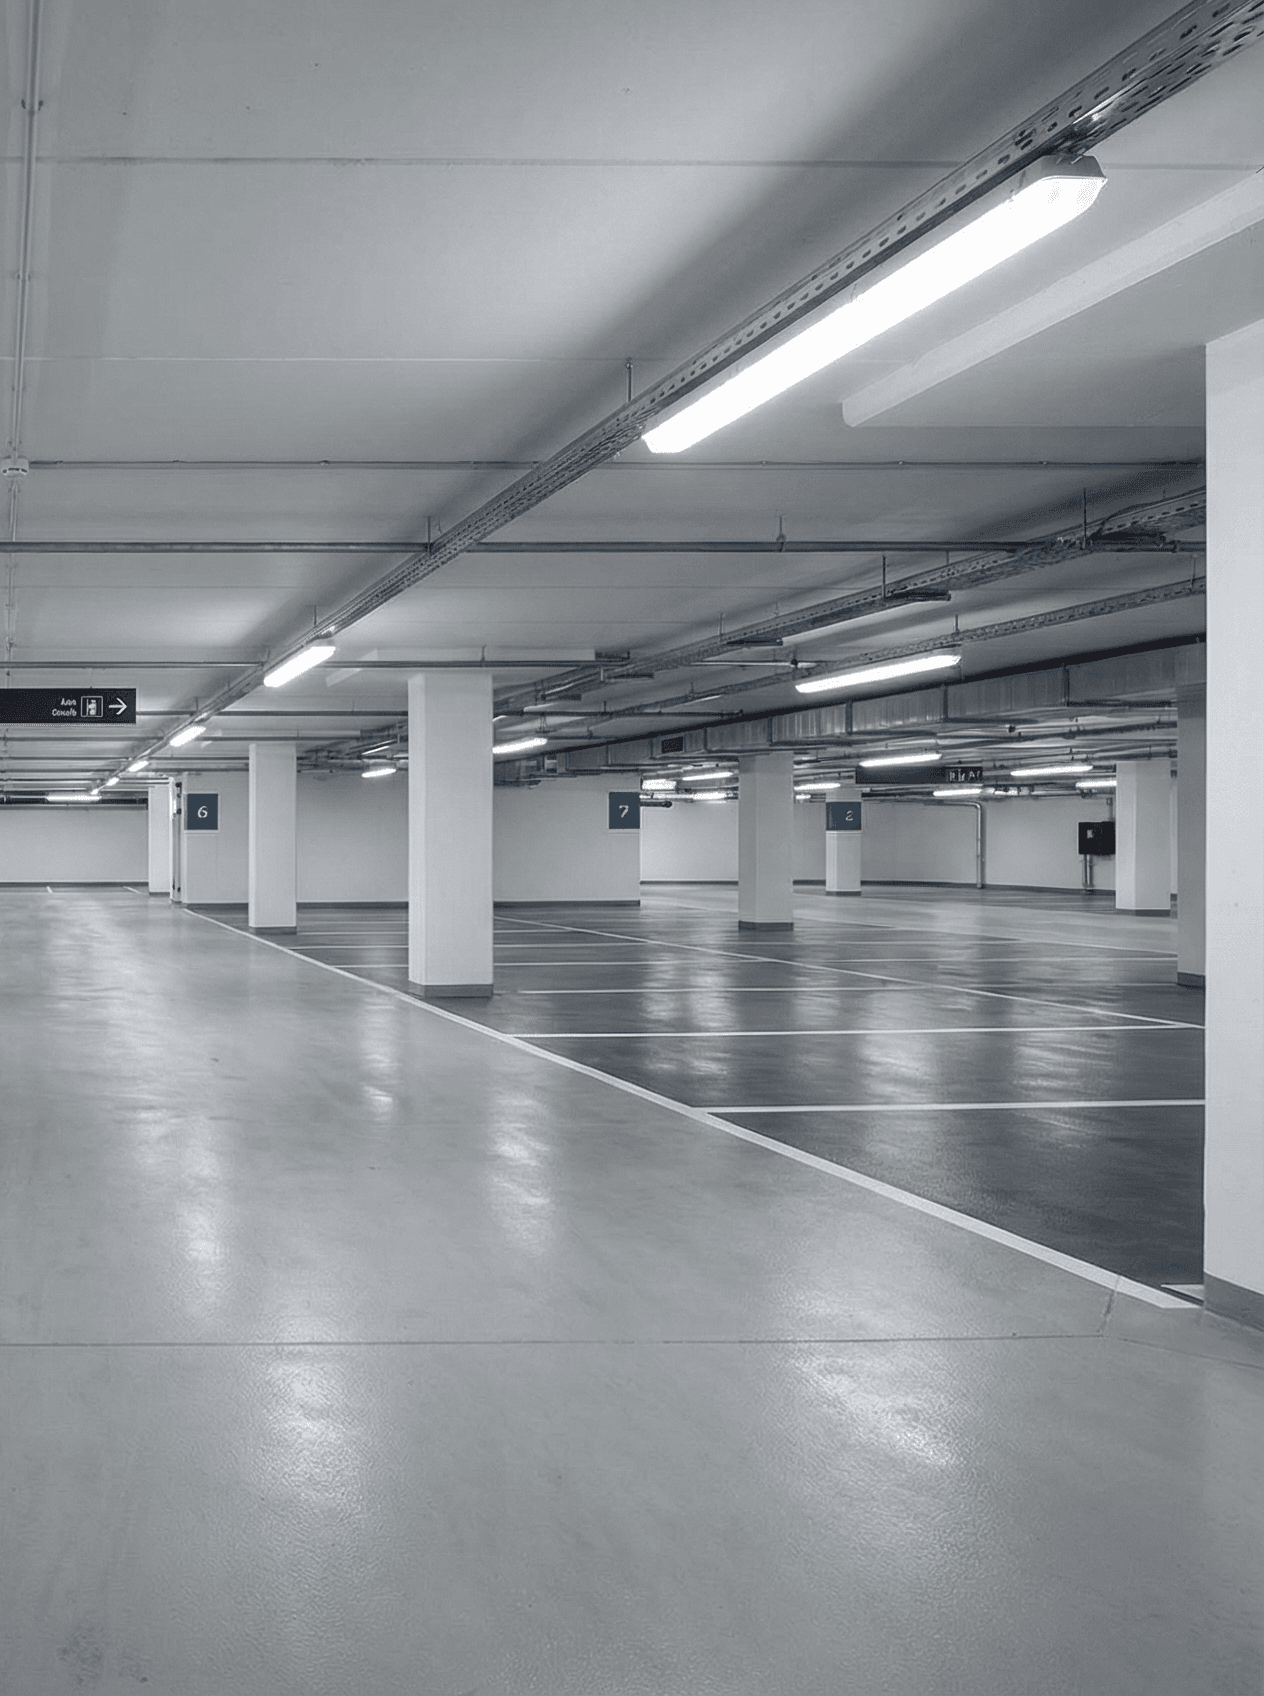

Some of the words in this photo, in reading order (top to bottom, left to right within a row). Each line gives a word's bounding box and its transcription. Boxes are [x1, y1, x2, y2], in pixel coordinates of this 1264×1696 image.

[197, 805, 208, 818] 6
[619, 805, 629, 818] 7
[845, 810, 854, 821] 2
